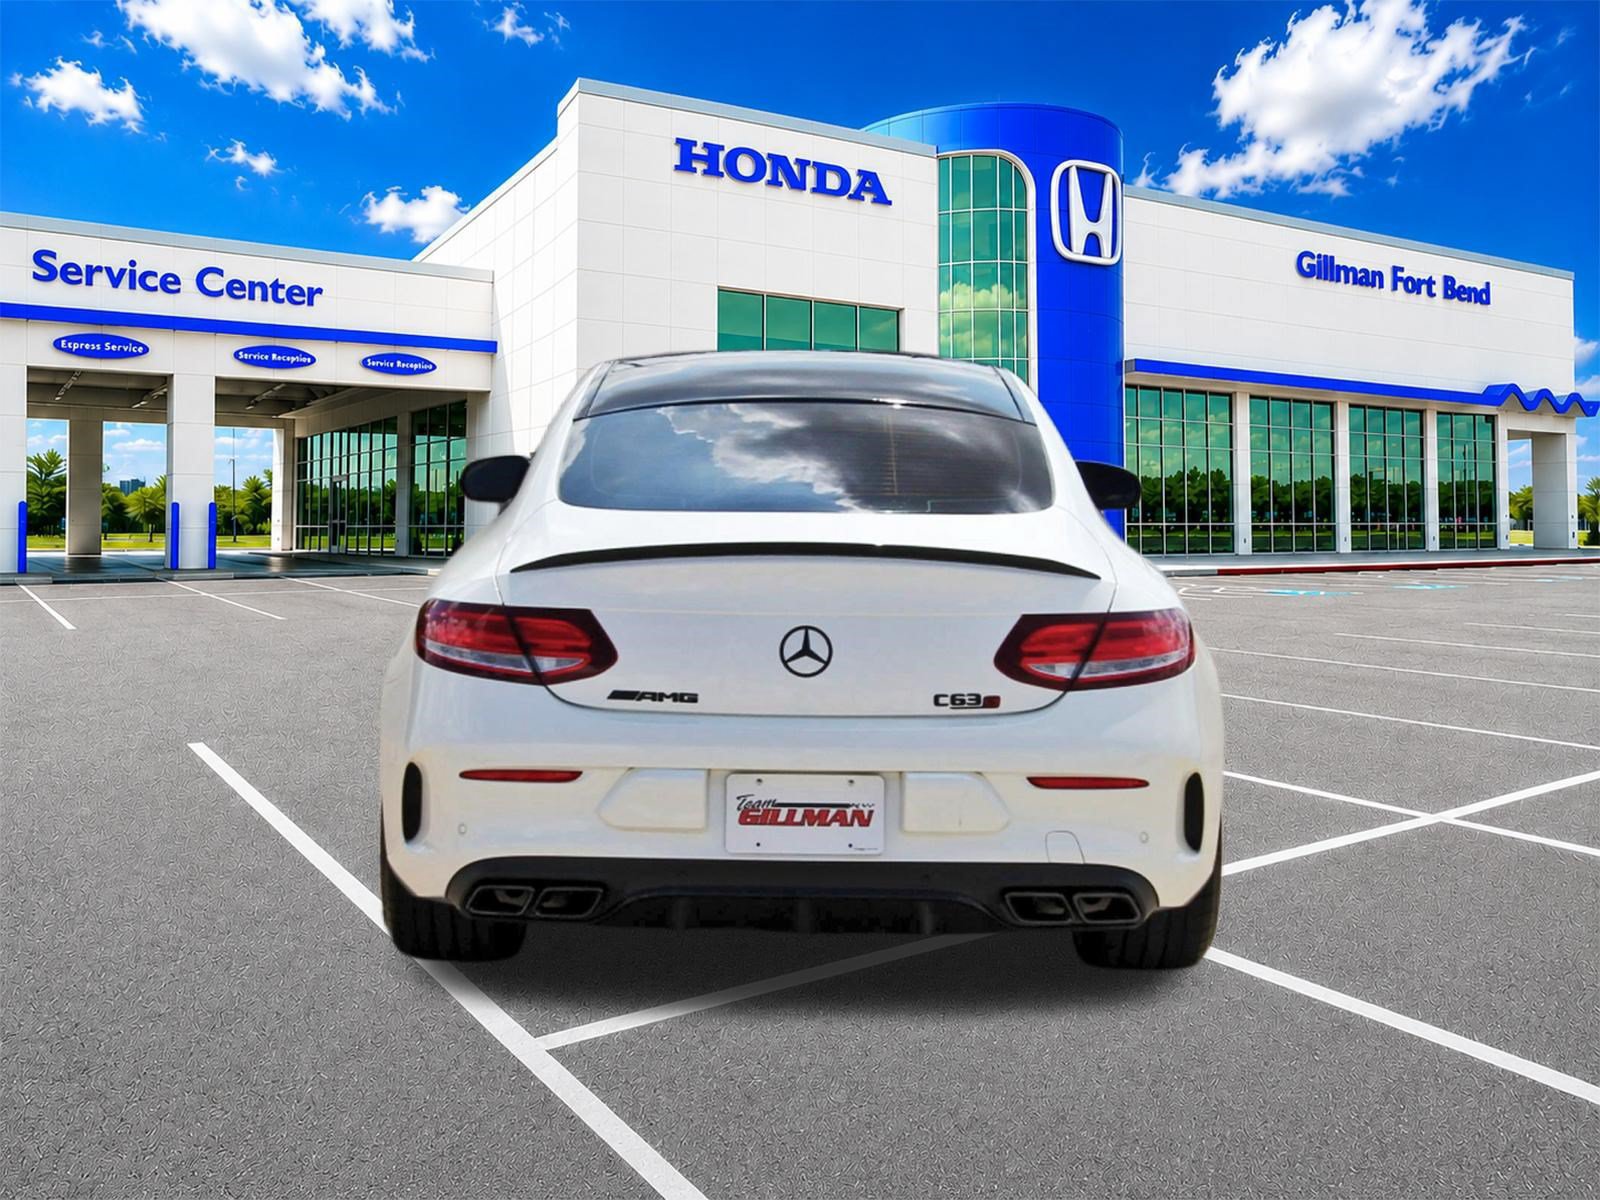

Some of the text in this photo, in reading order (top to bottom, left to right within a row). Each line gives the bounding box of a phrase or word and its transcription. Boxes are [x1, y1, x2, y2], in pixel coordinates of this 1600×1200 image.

[674, 137, 892, 206] HONDA
[32, 249, 323, 306] Service Center
[1296, 250, 1491, 305] Gillman Fort Bend
[104, 342, 144, 353] Service
[238, 351, 269, 361] Service
[367, 358, 394, 368] Service
[635, 691, 699, 703] AMG
[736, 794, 777, 811] Team
[738, 808, 874, 827] GILLMAN
